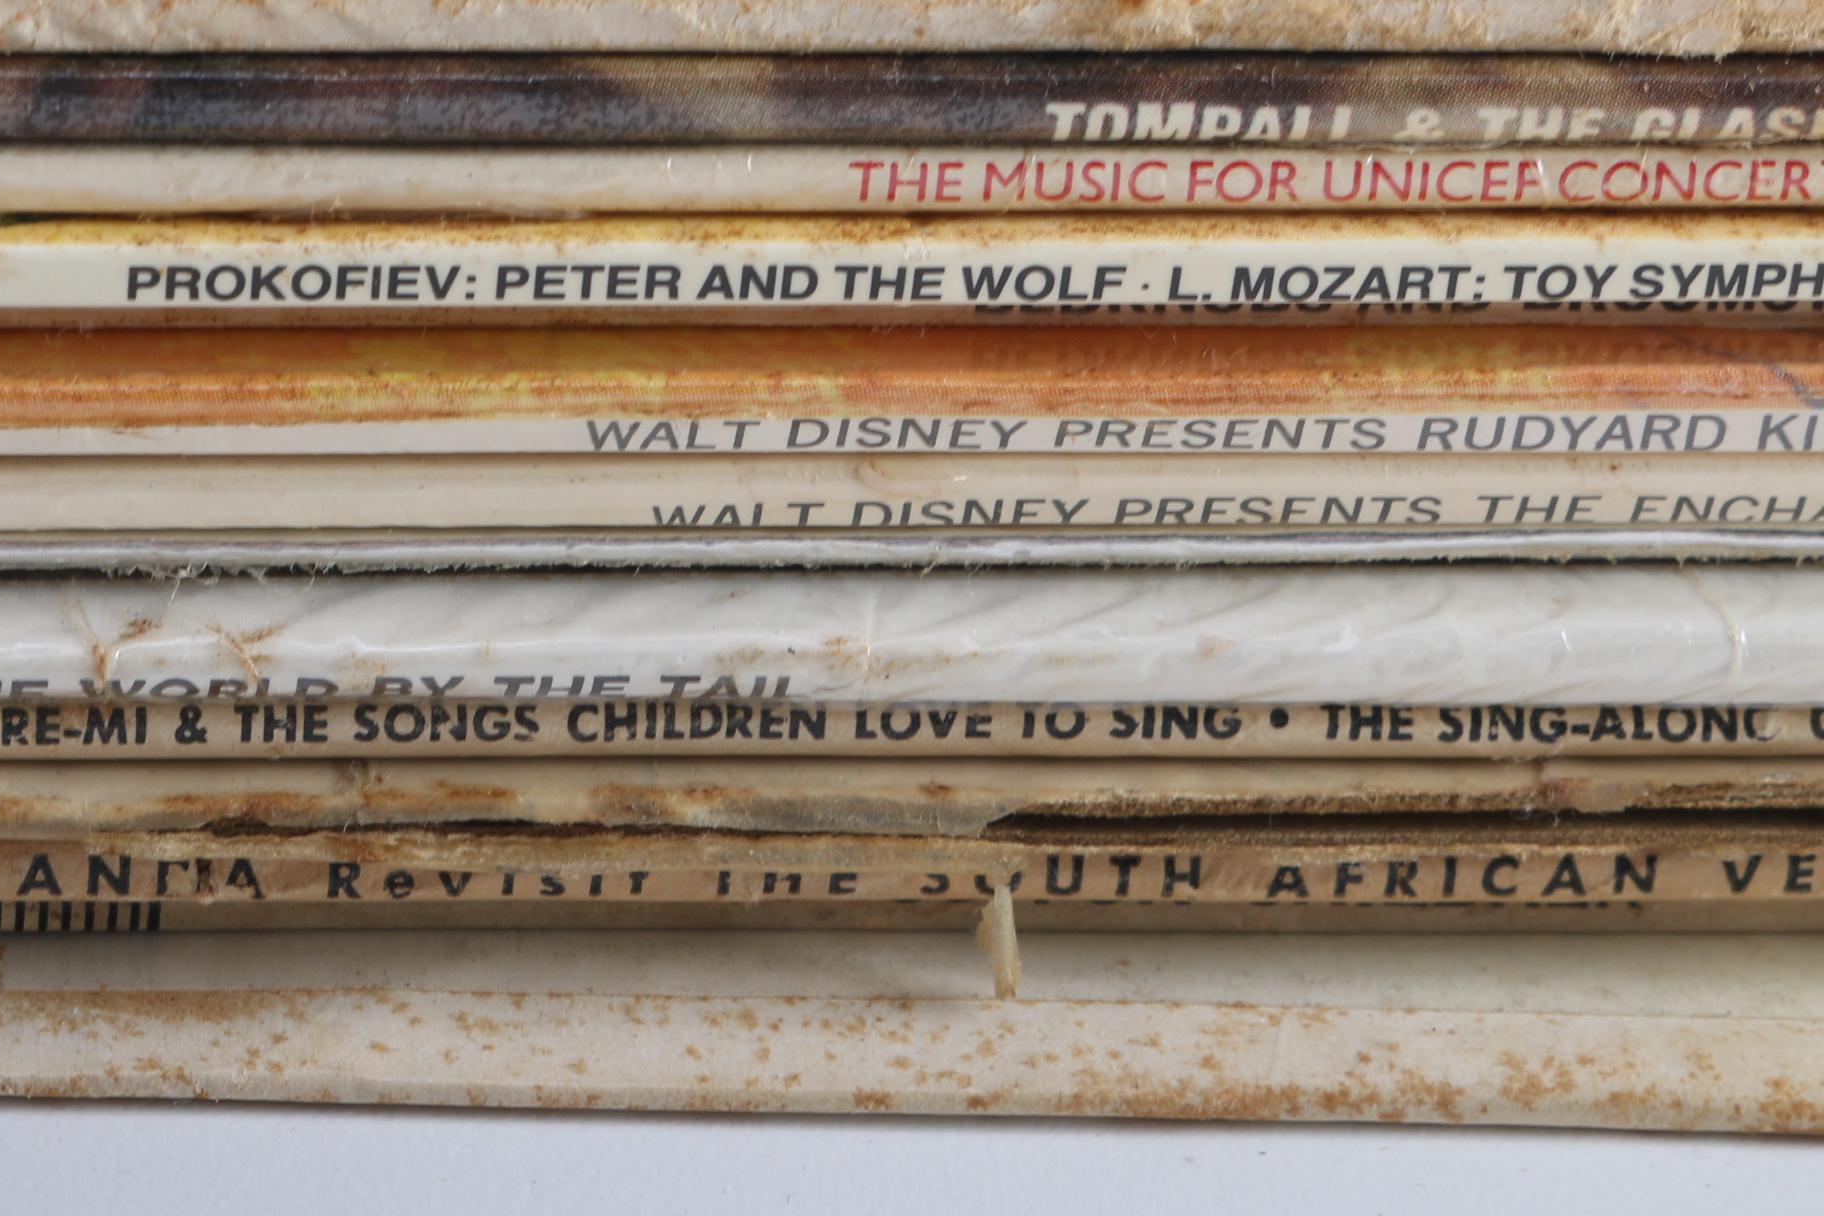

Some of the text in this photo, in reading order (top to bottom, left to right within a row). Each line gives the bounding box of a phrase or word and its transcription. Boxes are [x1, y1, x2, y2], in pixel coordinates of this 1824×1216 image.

[1395, 107, 1446, 141] &
[1478, 106, 1607, 141] THE
[1630, 106, 1824, 141] GLAS
[848, 159, 1824, 204] THE MUSIC FOR UNICEF CONCER
[126, 264, 477, 301] PROKOFIEV:
[495, 264, 682, 301] PETER
[695, 264, 819, 301] AND
[833, 264, 945, 300] THE
[961, 264, 1128, 301] WOLF
[1167, 264, 1212, 300] L.
[1502, 263, 1618, 300] TOY
[1628, 262, 1824, 299] SYMPH
[586, 419, 761, 452] WALT
[786, 417, 1028, 451] DISNEY
[1052, 417, 1387, 451] PRESENTS
[1415, 414, 1728, 452] RUDYARD
[651, 494, 1824, 528] WALT DISNEY PRESENTS THE ENCH
[174, 705, 208, 744] &
[233, 704, 329, 744] THE
[353, 702, 541, 742] SONGS
[567, 701, 828, 741] CHILDREN
[855, 702, 992, 740] LOVE
[1021, 702, 1087, 740] TO
[1109, 704, 1244, 741] SING
[1319, 703, 1414, 742] THE
[1265, 853, 1660, 900] AFRICAN
[1720, 853, 1819, 895] VE
